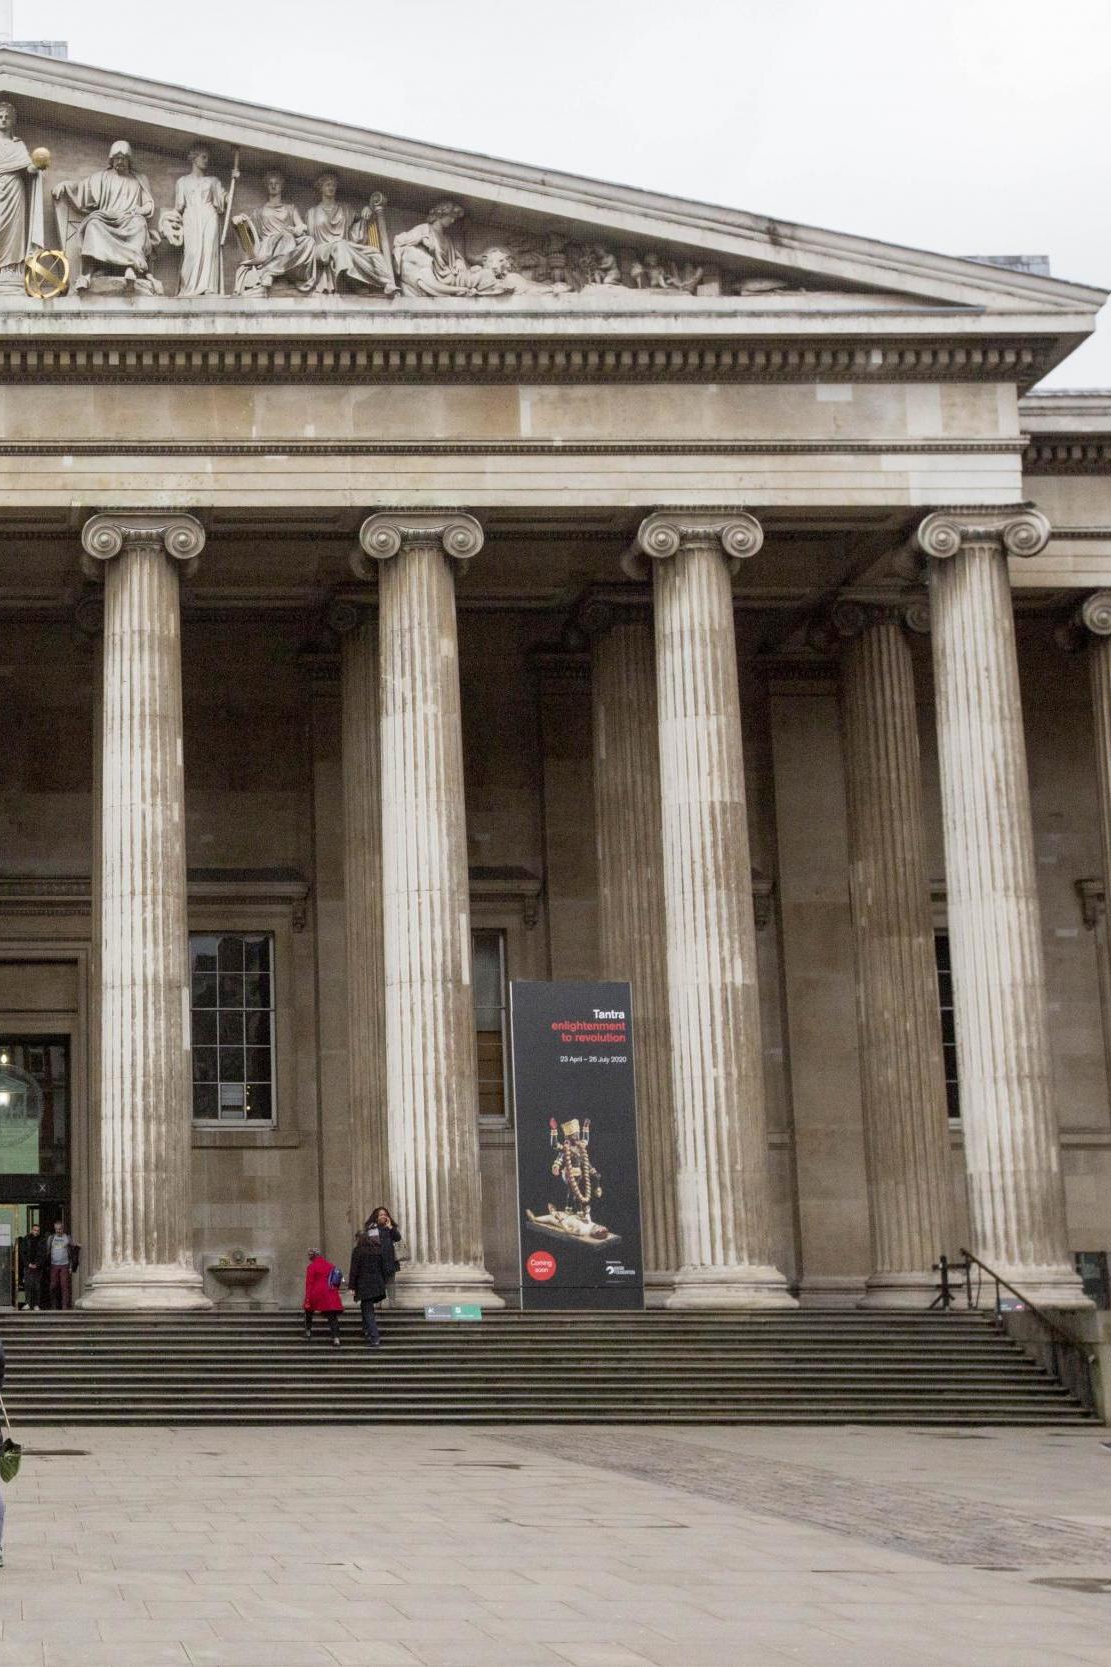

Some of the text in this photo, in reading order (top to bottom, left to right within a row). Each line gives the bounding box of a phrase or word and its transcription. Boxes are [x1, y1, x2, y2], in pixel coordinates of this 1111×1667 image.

[593, 1009, 625, 1019] Tantra
[552, 1021, 625, 1032] enlightenment
[562, 1032, 626, 1042] to revolution
[569, 1056, 583, 1064] April
[598, 1056, 610, 1064] July
[530, 1259, 553, 1268] Coming
